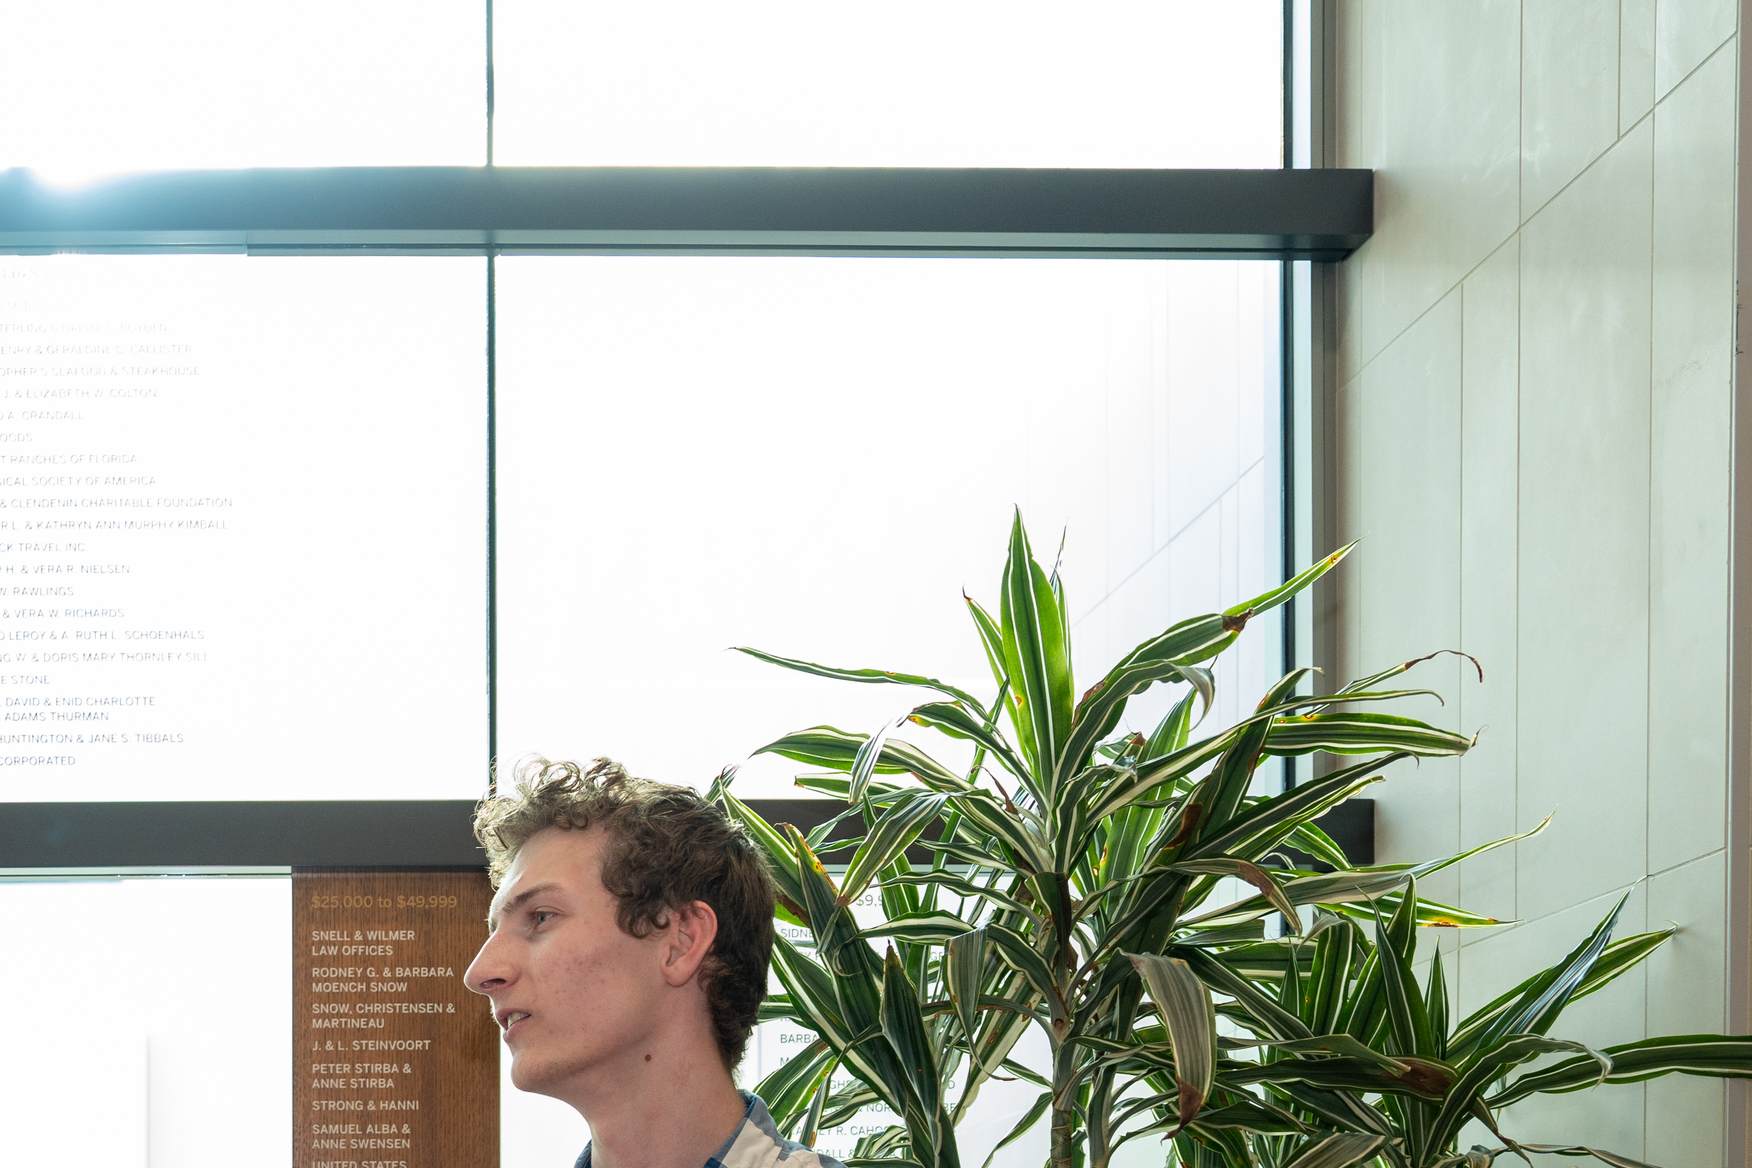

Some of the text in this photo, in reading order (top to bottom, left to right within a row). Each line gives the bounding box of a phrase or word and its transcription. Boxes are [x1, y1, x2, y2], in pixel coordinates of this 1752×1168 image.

[5, 712, 46, 721] ADAMS
[52, 712, 109, 721] THURMAN
[311, 894, 457, 909] $25,000 to $49,999
[312, 930, 415, 941] SNELL & WILMER
[312, 945, 393, 956] LAW OFFICES
[312, 982, 407, 992] MOENCH SNOW
[312, 1003, 455, 1014] SNOW, CHRISTENSEN &
[312, 1018, 384, 1028] MARTINEAU
[312, 1063, 412, 1074] PETER STIRBA &
[312, 1078, 394, 1088] ANNE STIRBA
[312, 1100, 419, 1111] STRONG & HANNI
[312, 1124, 411, 1134] SAMUEL ALBA &
[312, 1139, 410, 1149] ANNE SWENSEN
